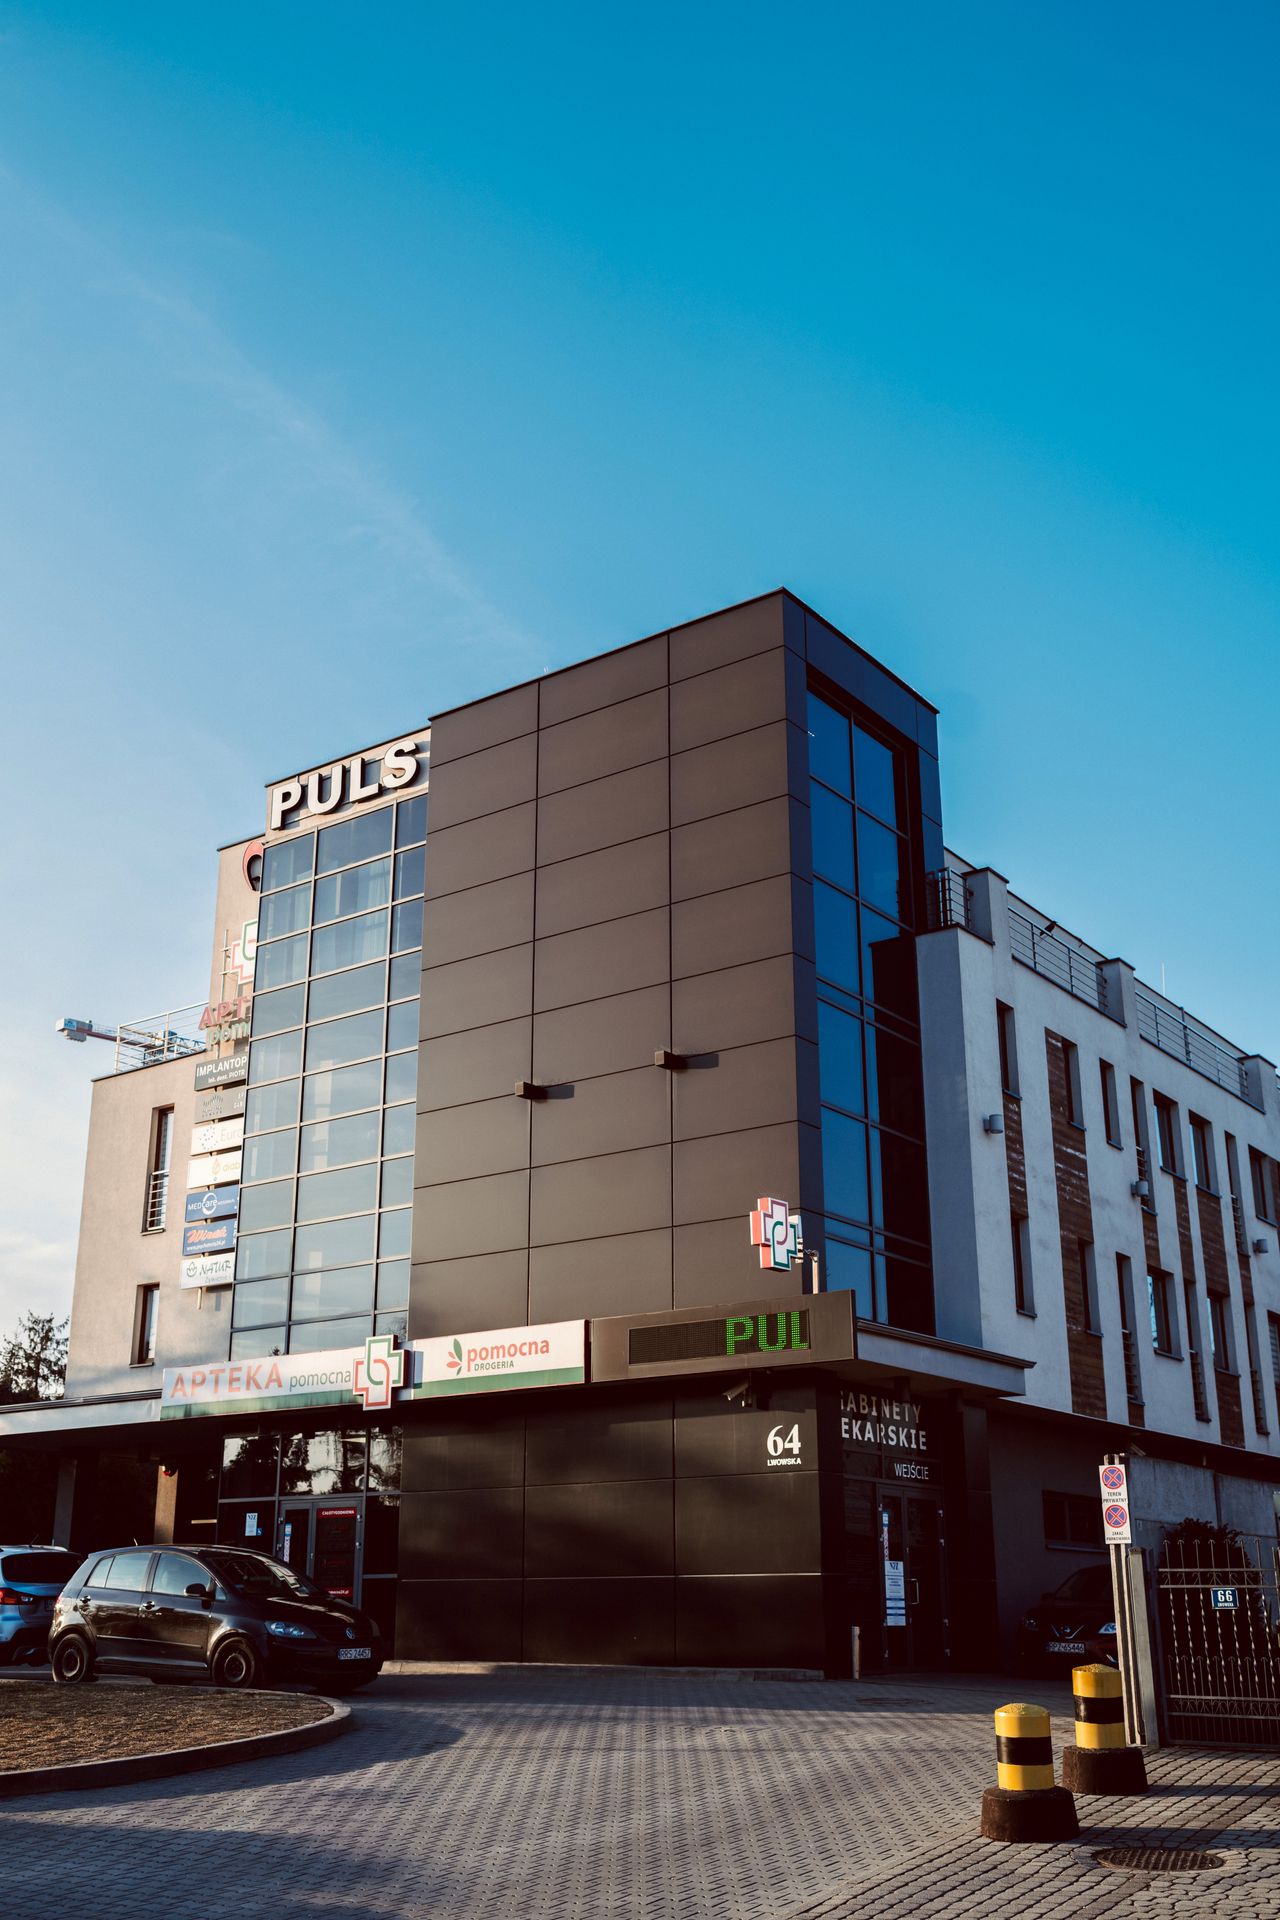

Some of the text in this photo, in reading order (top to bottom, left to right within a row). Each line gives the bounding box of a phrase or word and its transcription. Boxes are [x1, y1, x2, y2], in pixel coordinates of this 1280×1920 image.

[271, 739, 418, 830] PULS
[199, 996, 251, 1030] APT
[196, 1055, 247, 1077] IMPLANTOP
[228, 1069, 245, 1079] PIOTR
[199, 1260, 232, 1277] NATUR
[726, 1311, 809, 1356] PUL
[466, 1336, 549, 1373] pomocna
[474, 1359, 515, 1371] DROGERIA
[170, 1362, 352, 1398] APTEKA pomocna
[840, 1390, 920, 1424] ABINETY
[767, 1424, 802, 1457] 64
[767, 1457, 802, 1467] LWOWSKA
[895, 1462, 929, 1480] WEJŚCIE
[1217, 1590, 1233, 1602] 66
